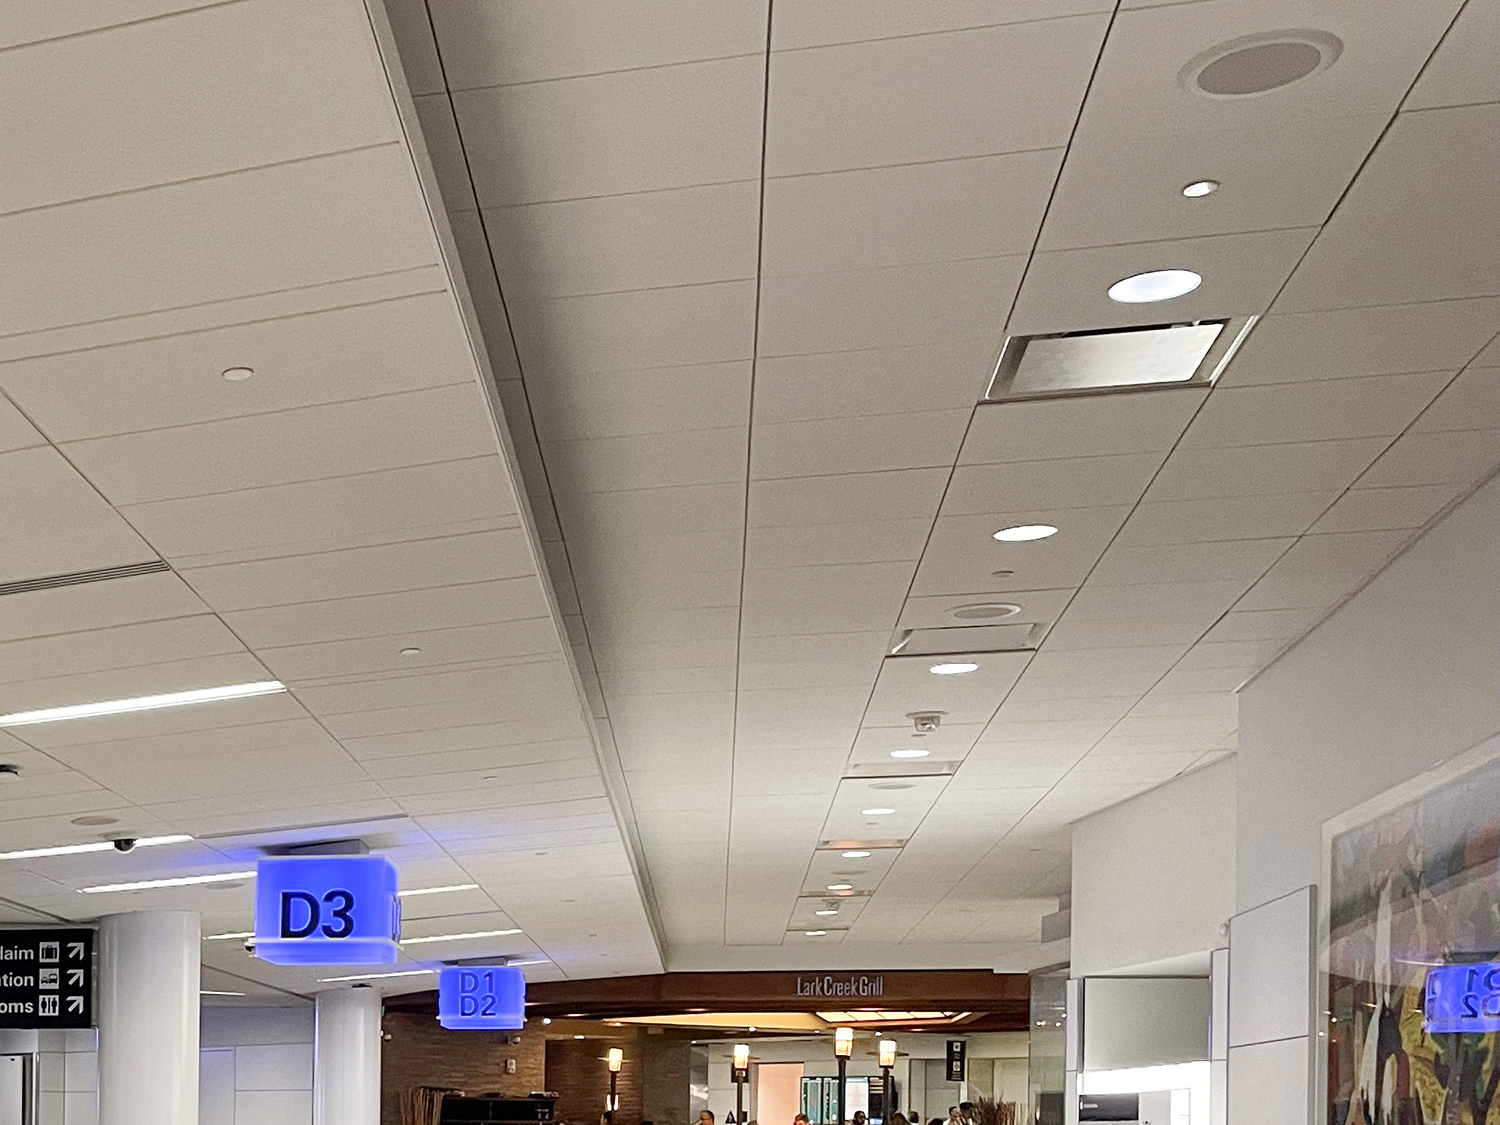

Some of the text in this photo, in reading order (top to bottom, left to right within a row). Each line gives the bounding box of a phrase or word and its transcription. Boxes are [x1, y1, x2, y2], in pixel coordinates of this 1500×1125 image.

[280, 889, 355, 939] D3
[460, 971, 494, 994] D1
[797, 976, 884, 996] Lark Creek Grill
[460, 994, 497, 1017] D2
